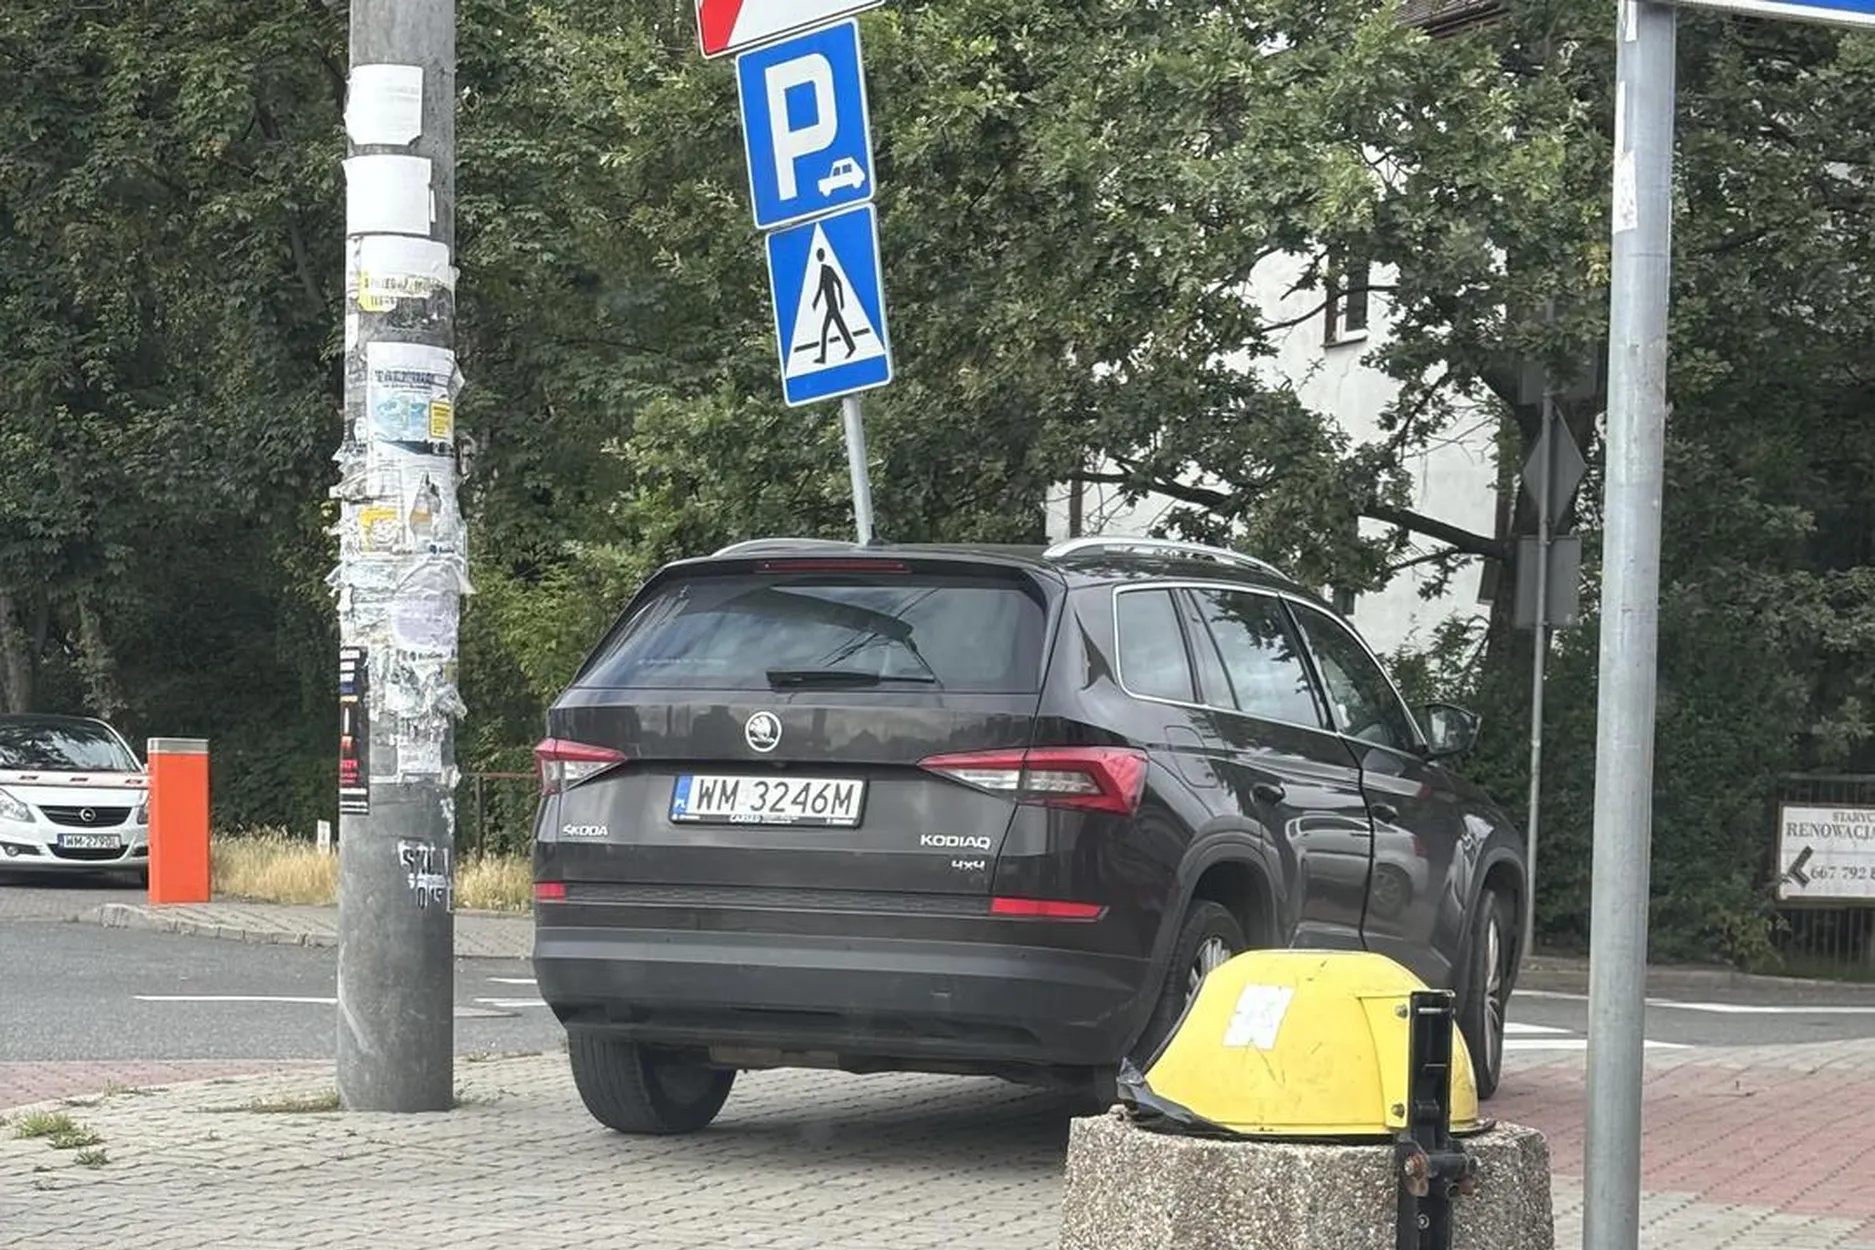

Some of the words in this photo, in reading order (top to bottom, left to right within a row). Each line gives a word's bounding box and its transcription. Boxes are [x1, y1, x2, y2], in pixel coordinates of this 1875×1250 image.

[765, 52, 839, 201] P
[696, 778, 740, 812] WM
[750, 781, 855, 815] 3246M
[920, 833, 991, 850] KODIAQ
[951, 859, 986, 871] 4x4
[1810, 866, 1835, 880] 667
[1842, 866, 1868, 880] 792
